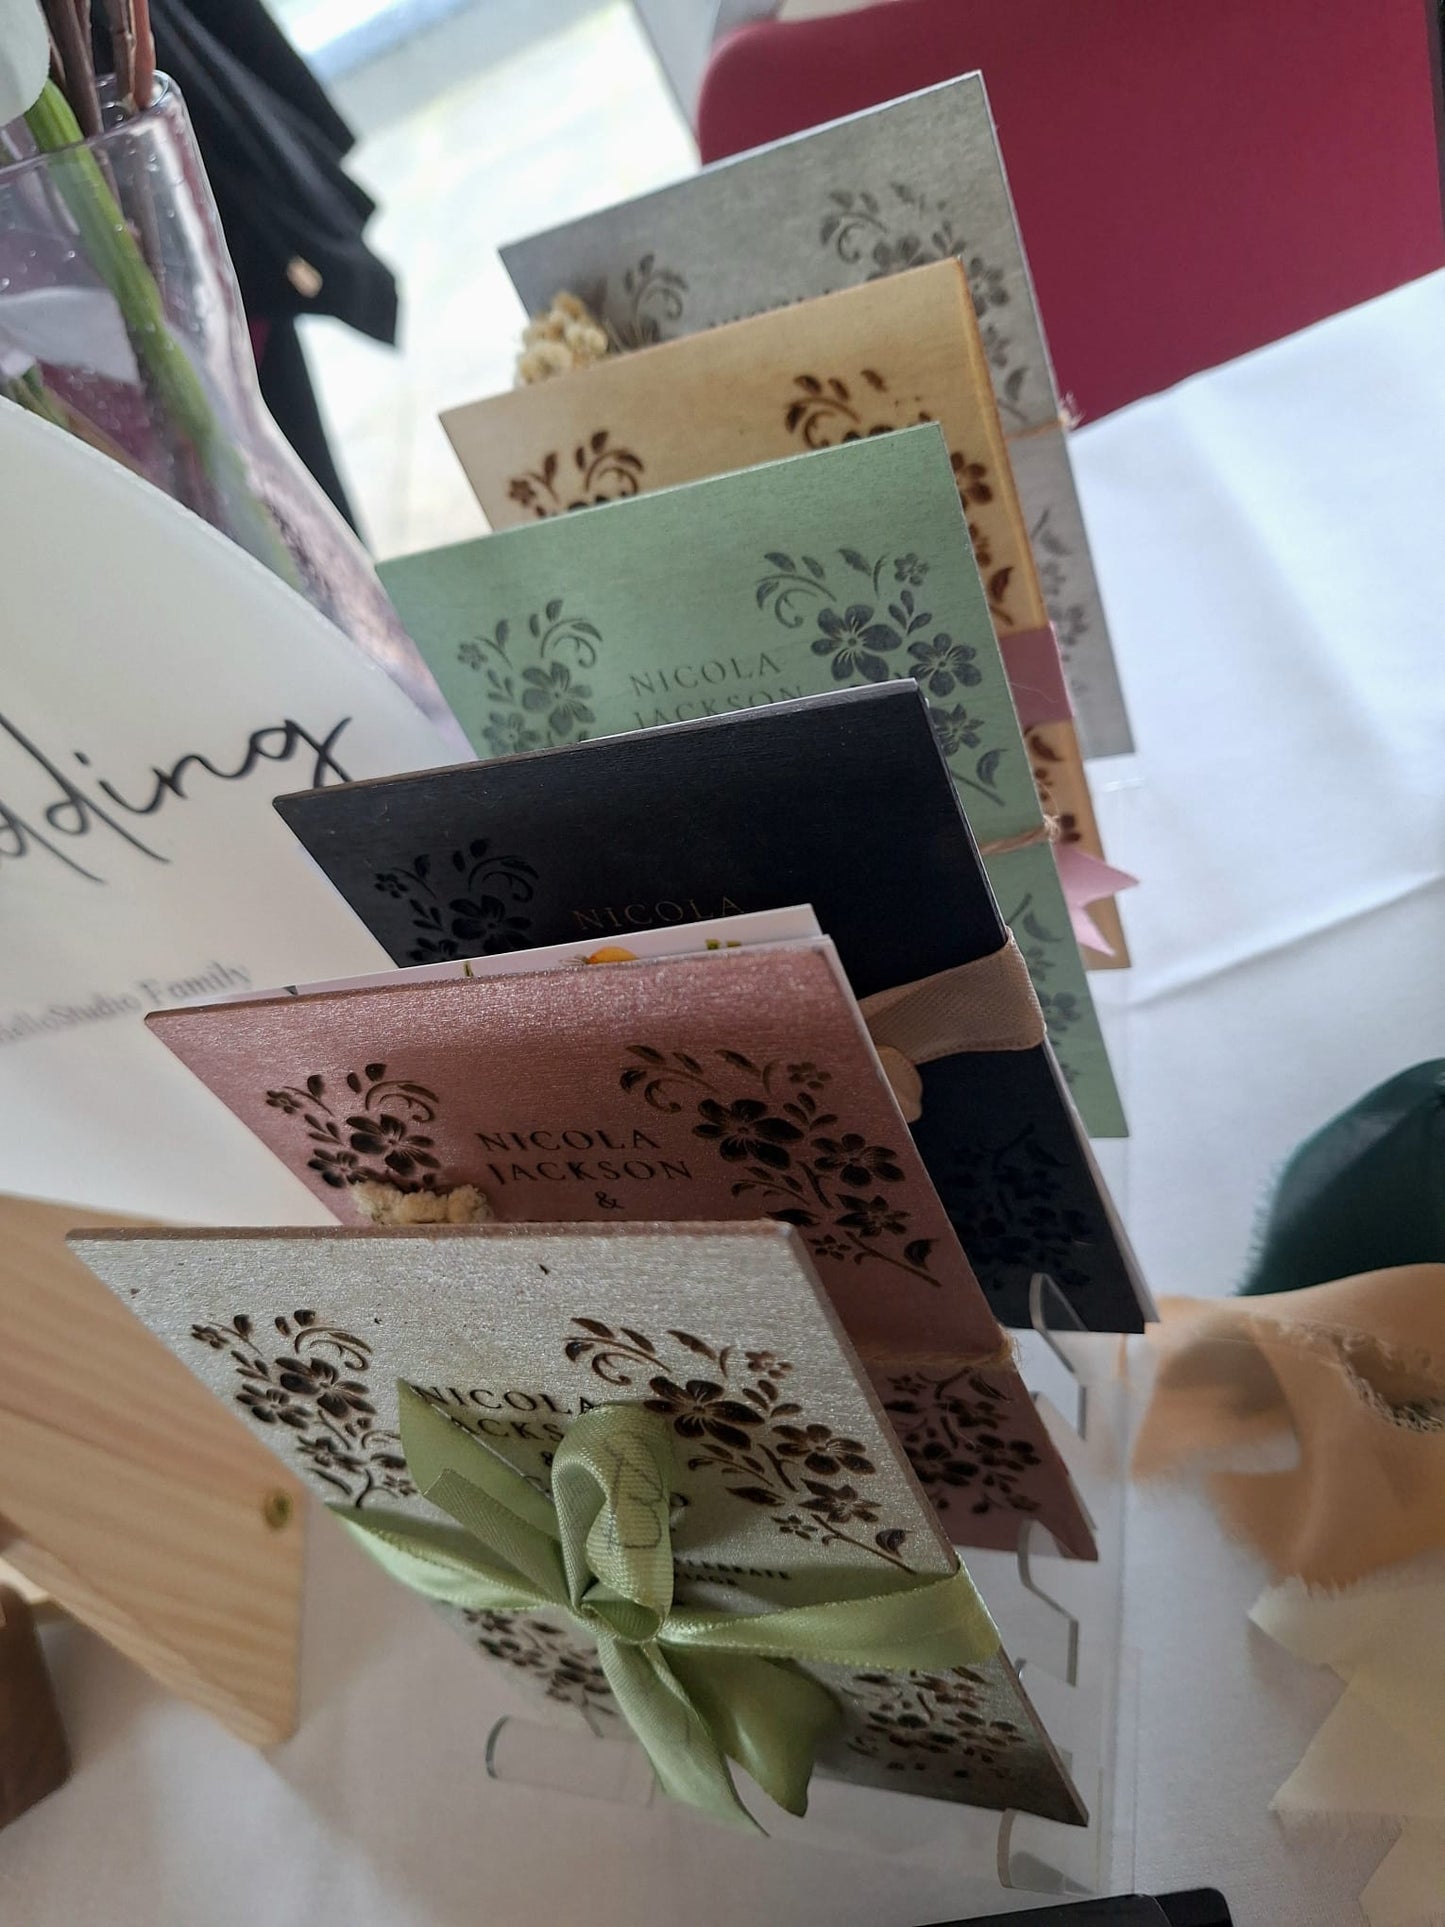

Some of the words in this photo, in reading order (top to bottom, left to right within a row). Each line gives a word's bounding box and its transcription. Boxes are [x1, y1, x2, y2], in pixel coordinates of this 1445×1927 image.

[628, 651, 782, 697] NICOLA
[571, 895, 745, 931] NICOLA
[133, 960, 252, 1006] Family
[473, 1128, 662, 1152] NICOLA
[486, 1159, 693, 1186] JACKSON
[594, 1191, 625, 1210] &
